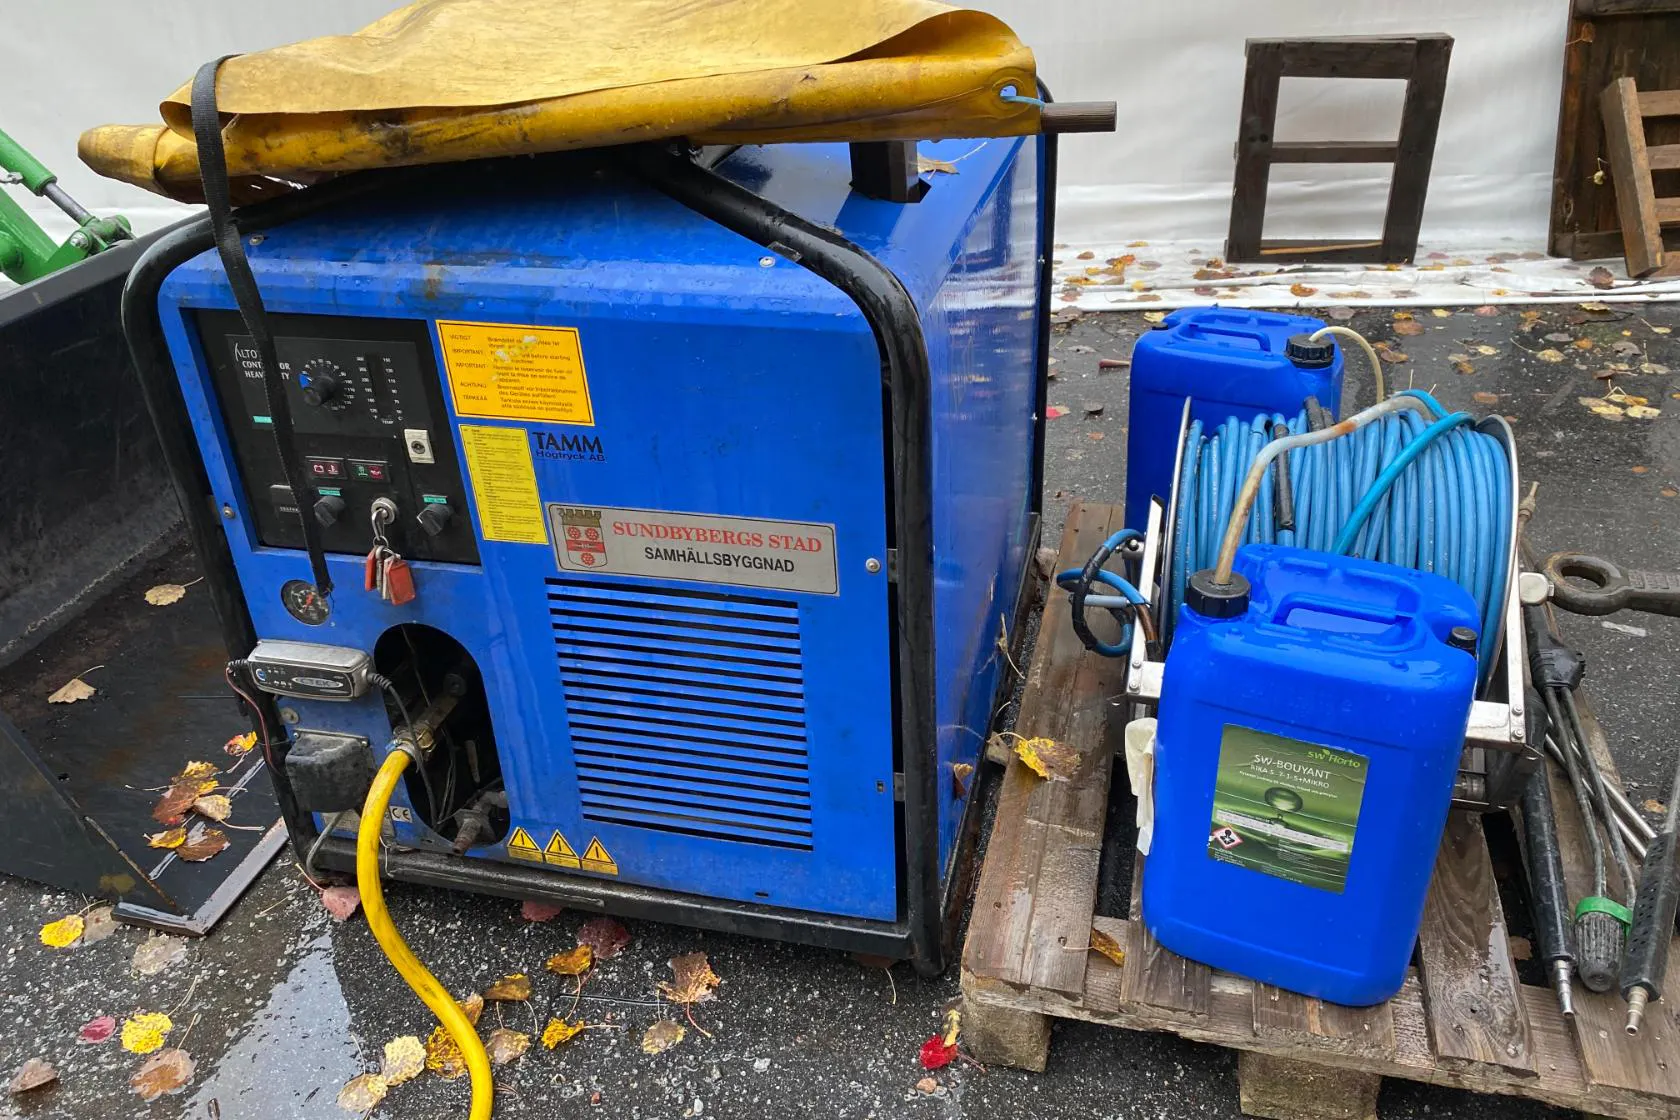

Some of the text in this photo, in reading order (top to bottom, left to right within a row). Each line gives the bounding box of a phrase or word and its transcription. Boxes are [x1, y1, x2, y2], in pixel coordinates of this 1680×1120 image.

[531, 431, 603, 454] TAMM
[589, 454, 606, 462] AB
[612, 521, 823, 552] SUNDBYBERGS STAD
[644, 546, 795, 572] SAMHÄLLSBYGGNAD
[1253, 753, 1331, 780] SW-BOUYANT
